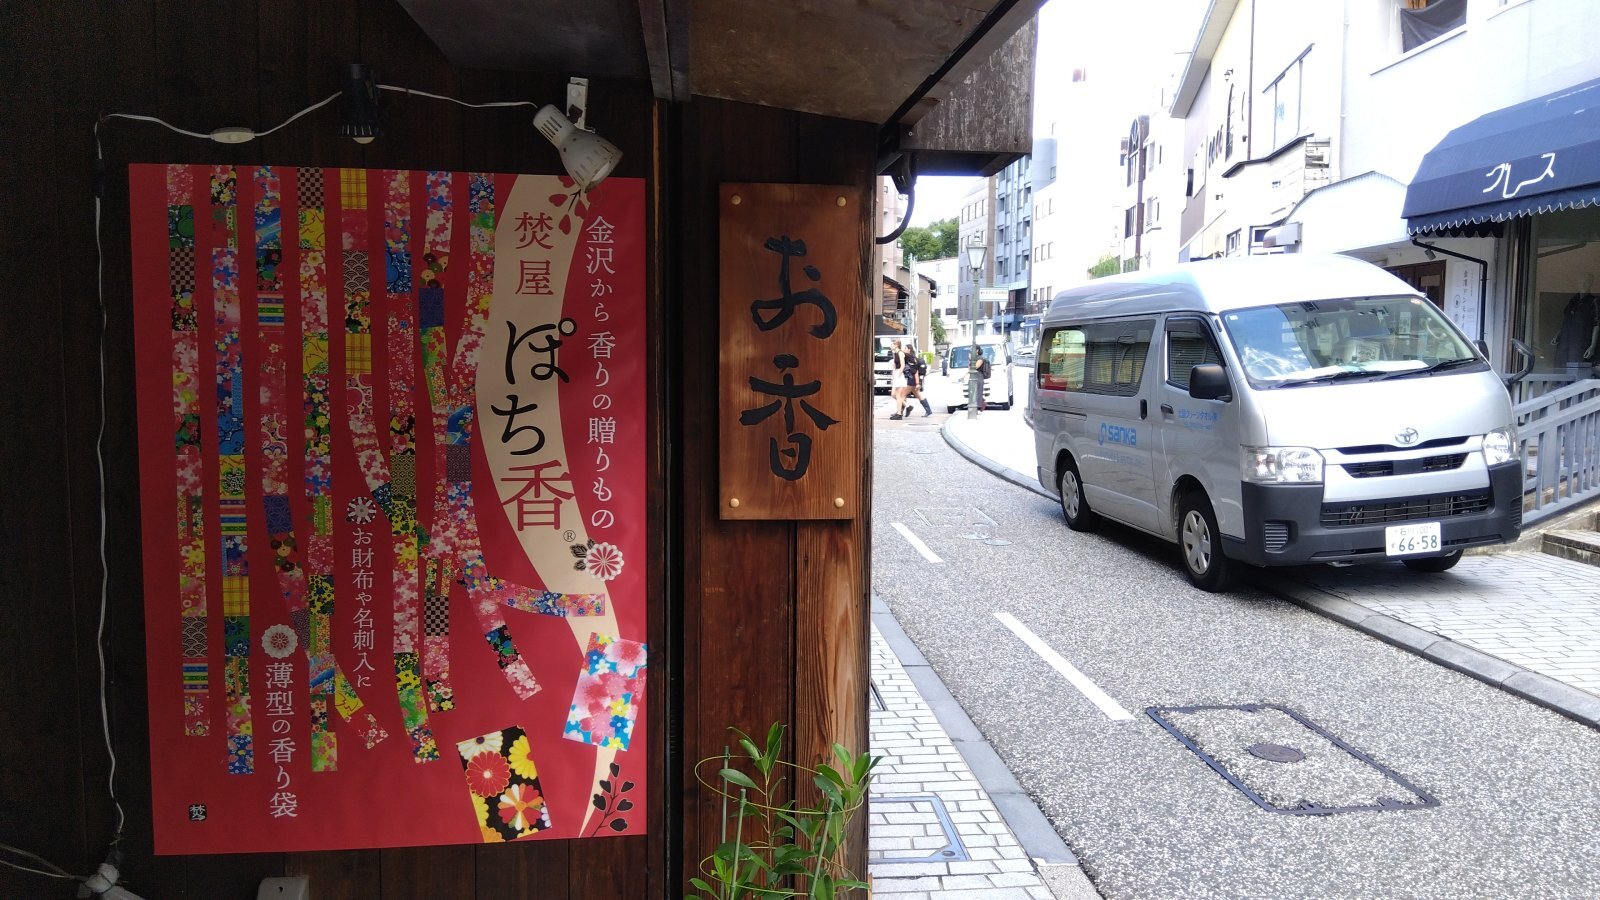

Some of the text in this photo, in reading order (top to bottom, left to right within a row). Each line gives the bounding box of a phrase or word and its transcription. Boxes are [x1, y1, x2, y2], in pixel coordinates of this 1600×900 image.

[490, 317, 577, 532] ぽち香
[738, 235, 841, 481] お香
[1107, 425, 1137, 447] sanka
[1398, 534, 1438, 552] 66-58
[265, 662, 298, 819] 薄型の香り袋
